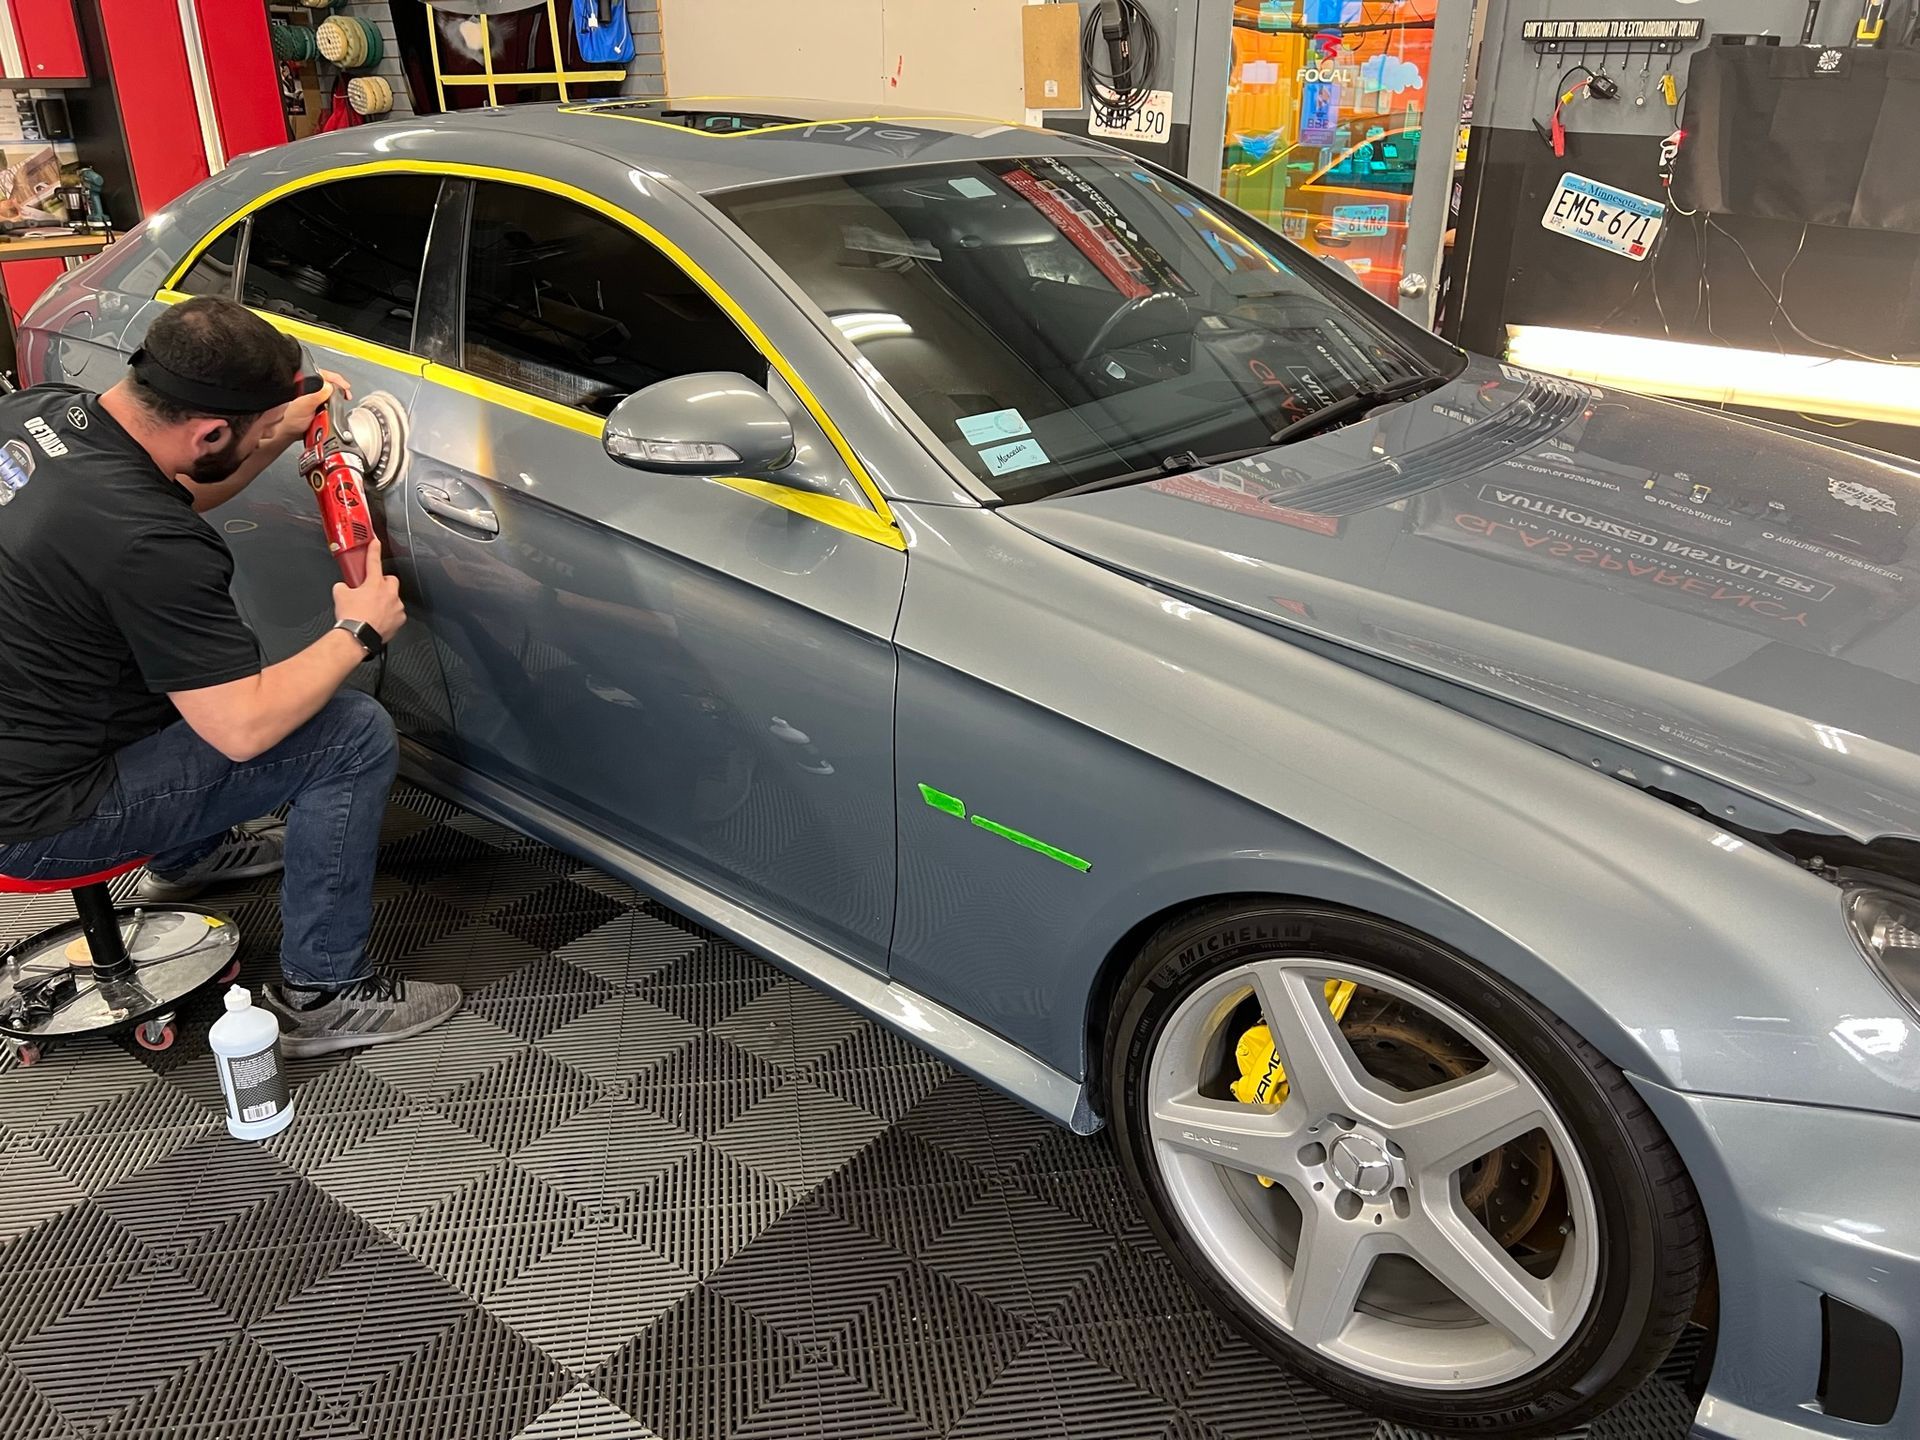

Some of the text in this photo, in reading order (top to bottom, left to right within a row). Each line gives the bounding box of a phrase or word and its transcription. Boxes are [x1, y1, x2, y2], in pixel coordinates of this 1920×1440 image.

[1523, 22, 1543, 38] DON'T
[1542, 22, 1558, 38] WAIT
[1557, 22, 1575, 37] UNTIL
[1575, 22, 1610, 37] TOMORROW
[1678, 21, 1699, 36] TODAY
[1296, 69, 1351, 83] FOCAL
[1553, 189, 1651, 245] EMS 671
[24, 416, 69, 458] DETAILER
[1178, 925, 1301, 969] MICHELIN
